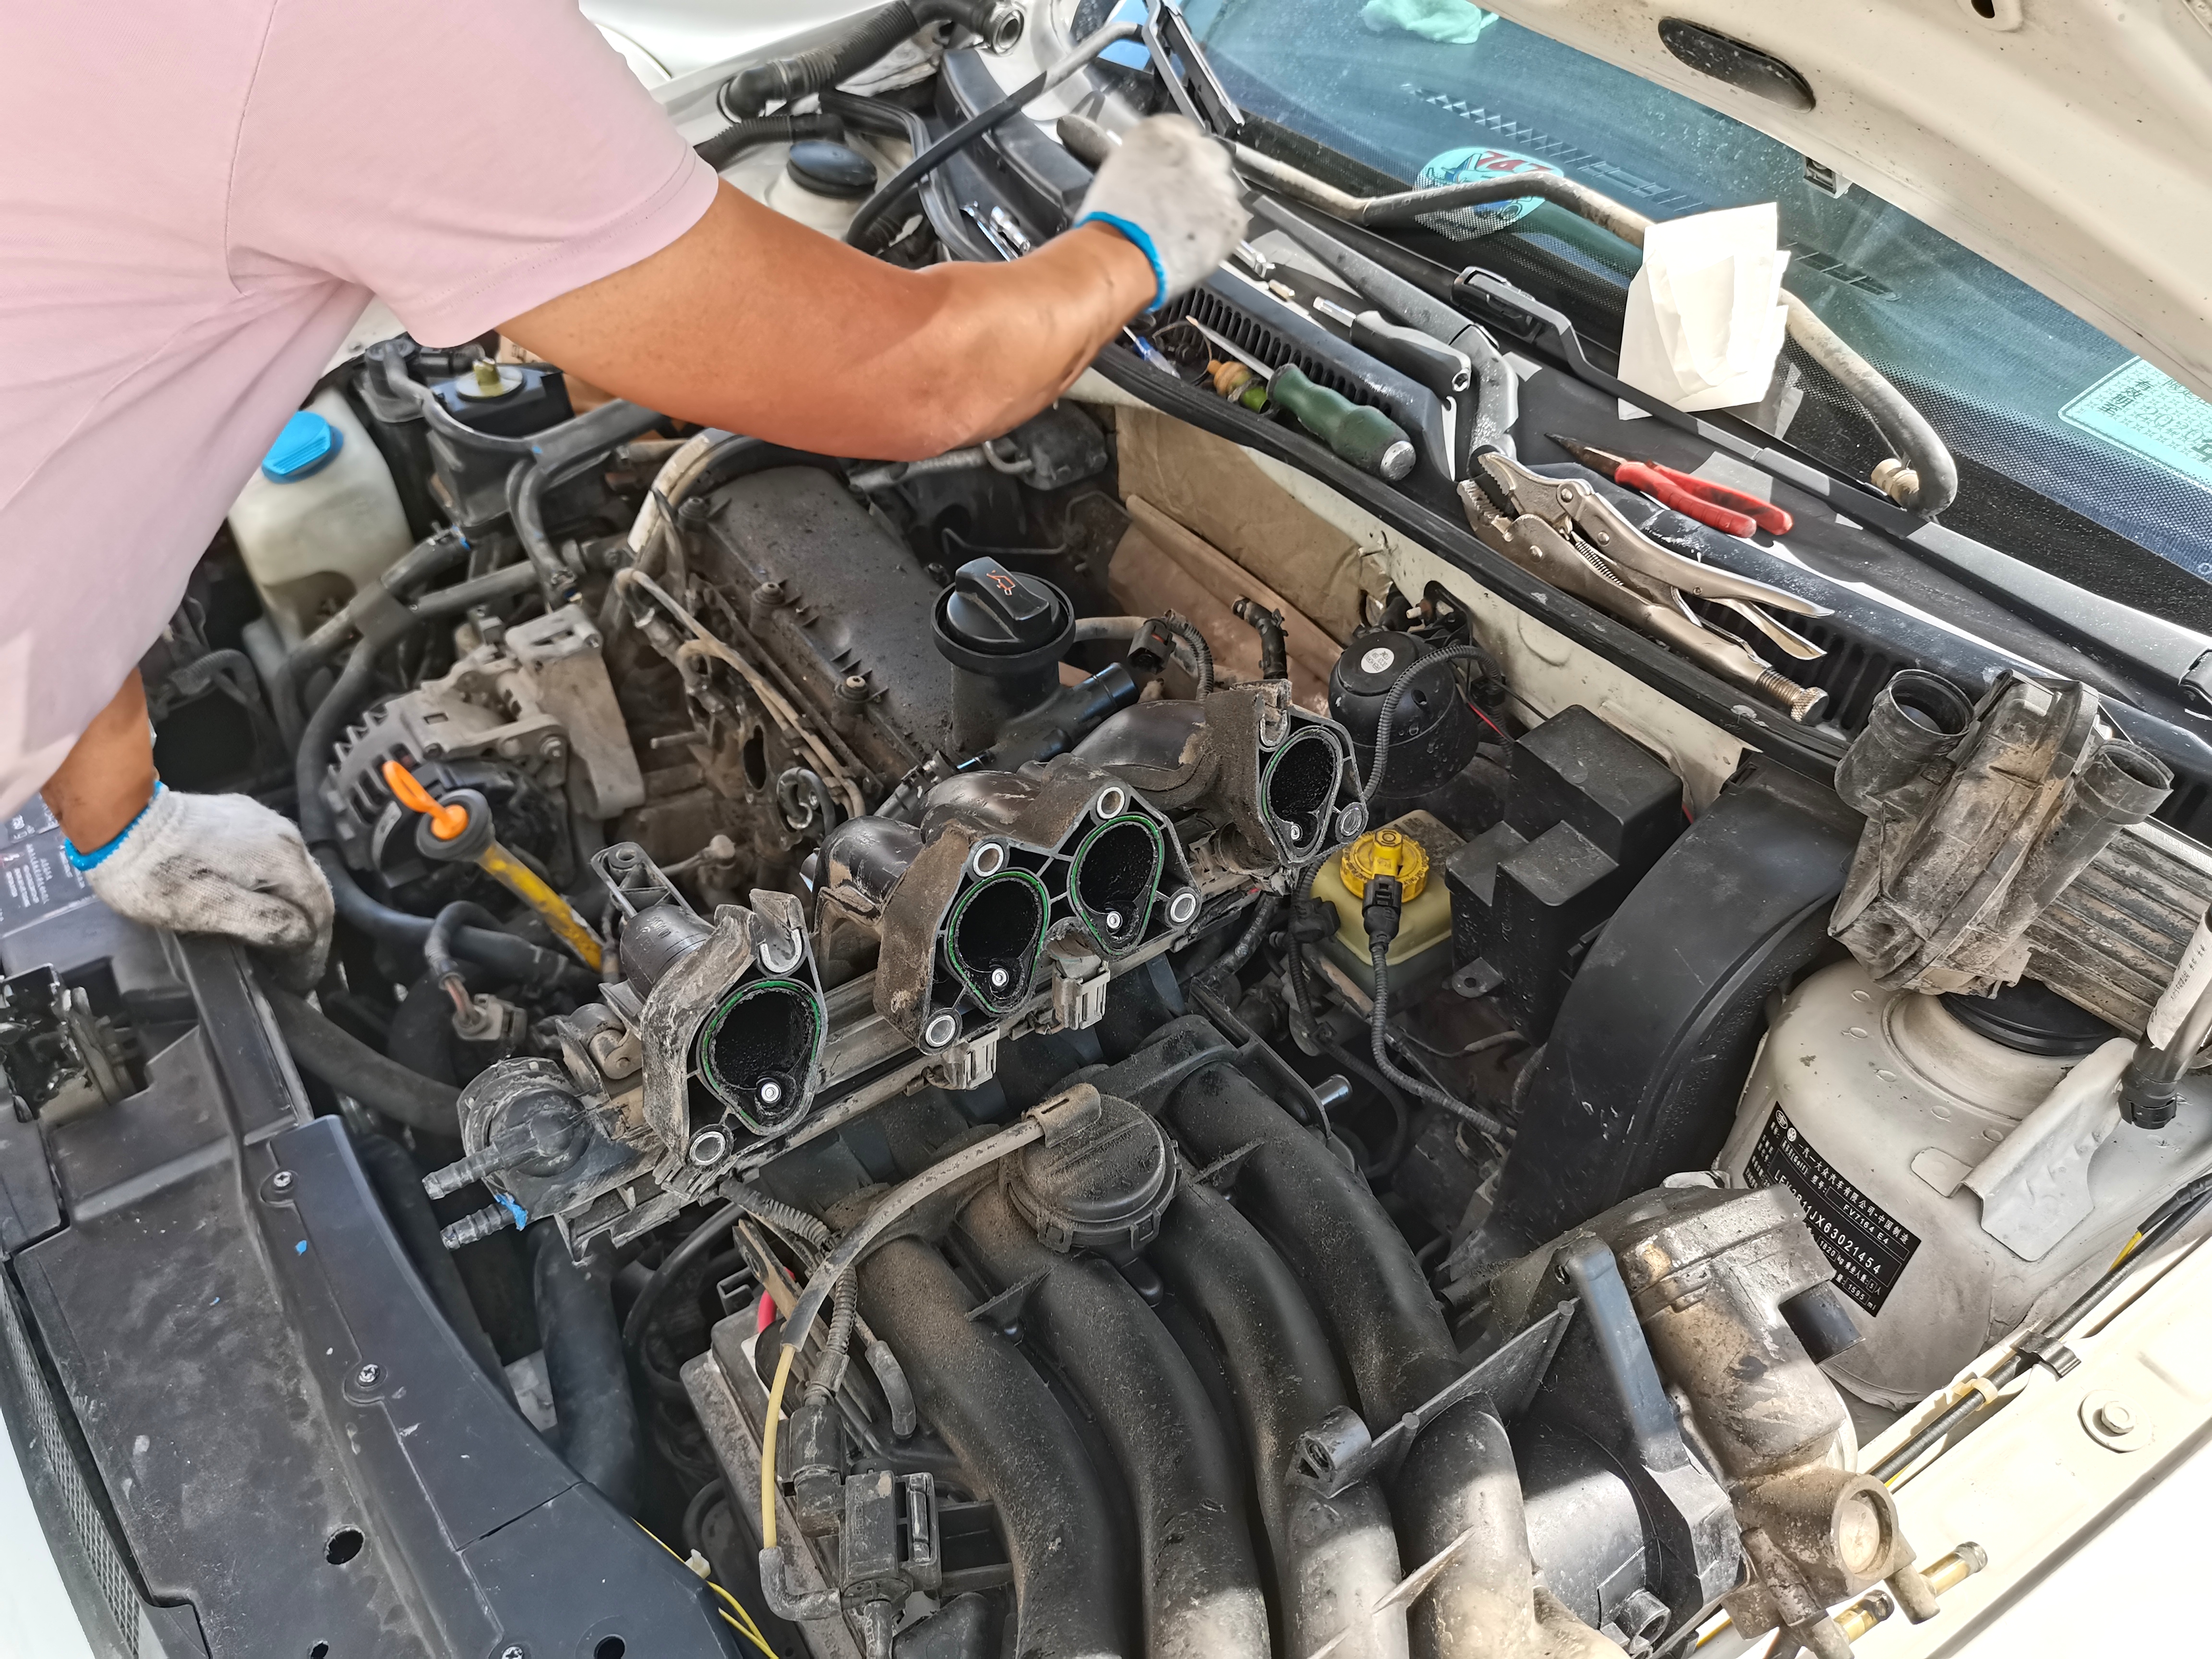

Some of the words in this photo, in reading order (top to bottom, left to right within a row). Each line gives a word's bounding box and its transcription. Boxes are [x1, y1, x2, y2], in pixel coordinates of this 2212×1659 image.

[2097, 379, 2153, 416] 有效期至
[2137, 407, 2204, 443] 2020
[1842, 1204, 1875, 1235] FV7164
[1876, 1232, 1889, 1245] E4
[1819, 1240, 1836, 1258] 1820
[1848, 1283, 1865, 1301] 1595
